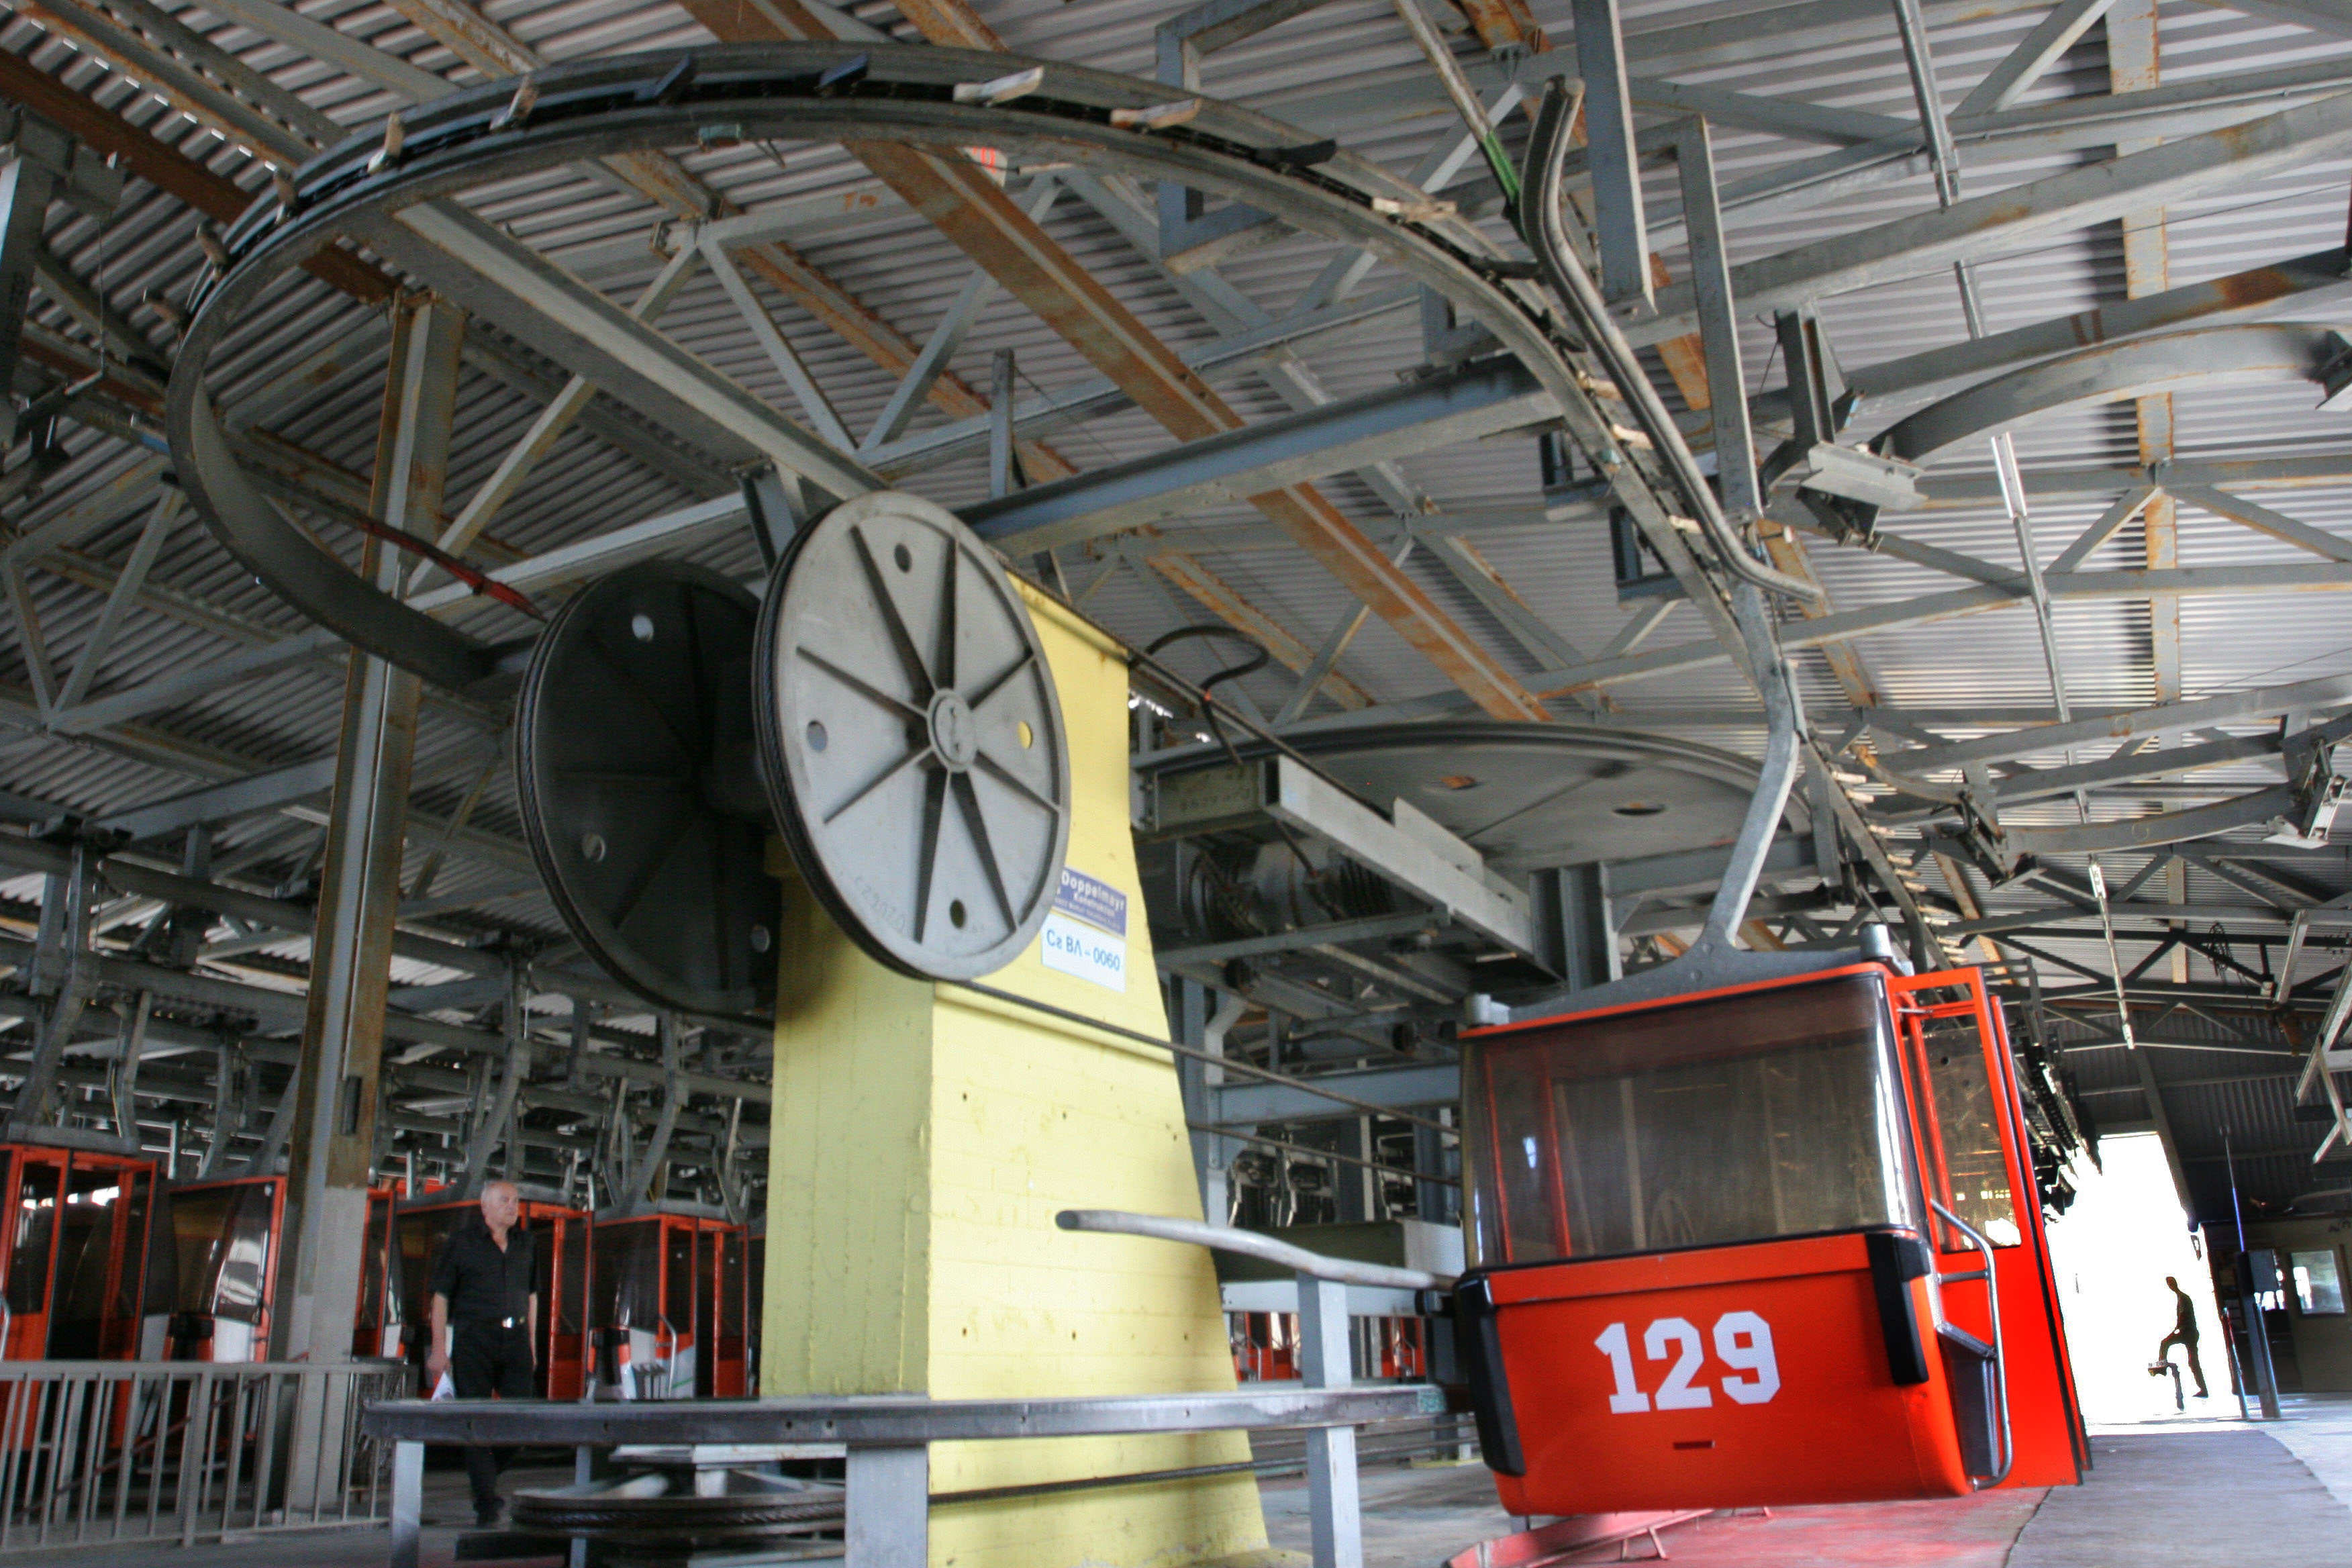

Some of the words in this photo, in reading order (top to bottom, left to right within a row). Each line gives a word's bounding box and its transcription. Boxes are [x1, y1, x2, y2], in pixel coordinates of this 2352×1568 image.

[1061, 871, 1124, 911] Doppelmayr
[1093, 948, 1120, 971] 0060
[1594, 1311, 1780, 1414] 129
